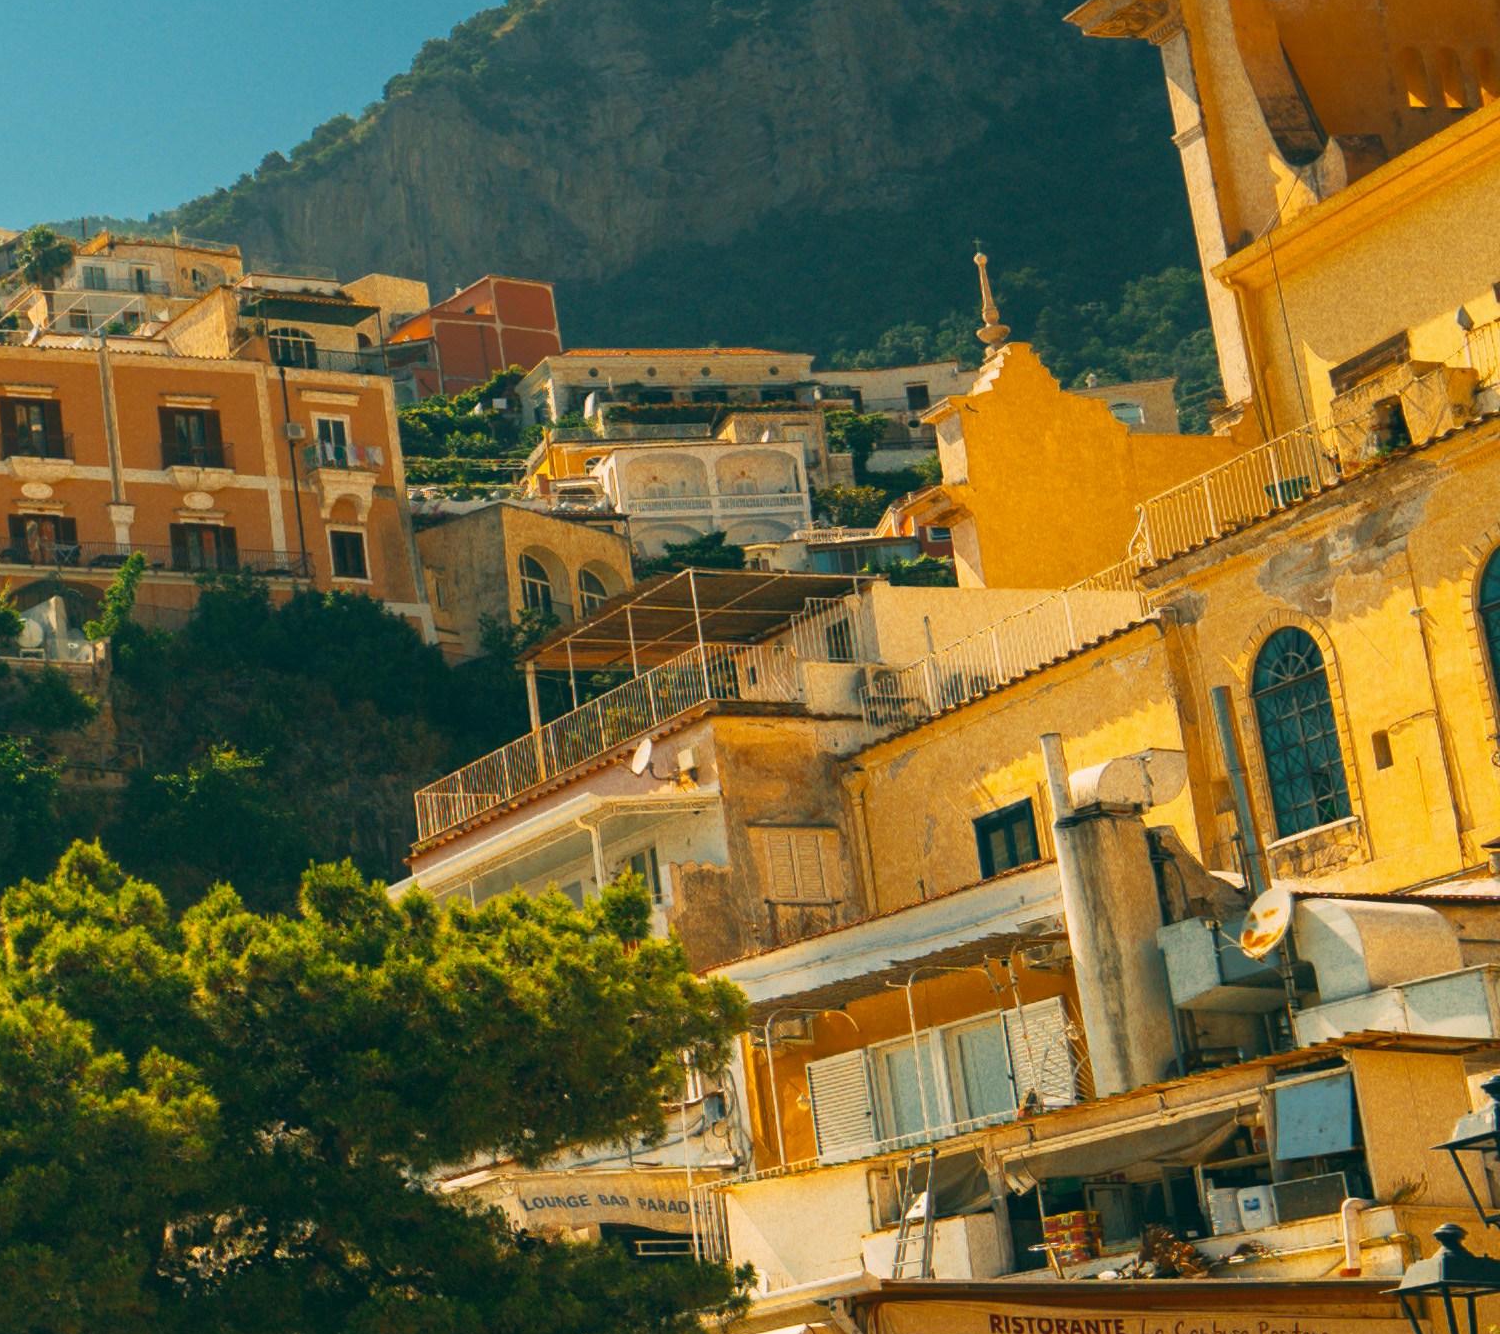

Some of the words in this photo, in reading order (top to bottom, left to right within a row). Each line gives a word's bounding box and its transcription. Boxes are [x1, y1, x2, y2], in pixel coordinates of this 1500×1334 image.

[522, 1193, 592, 1212] LOUNGE
[598, 1194, 631, 1209] BAR
[637, 1197, 712, 1215] PARADSE
